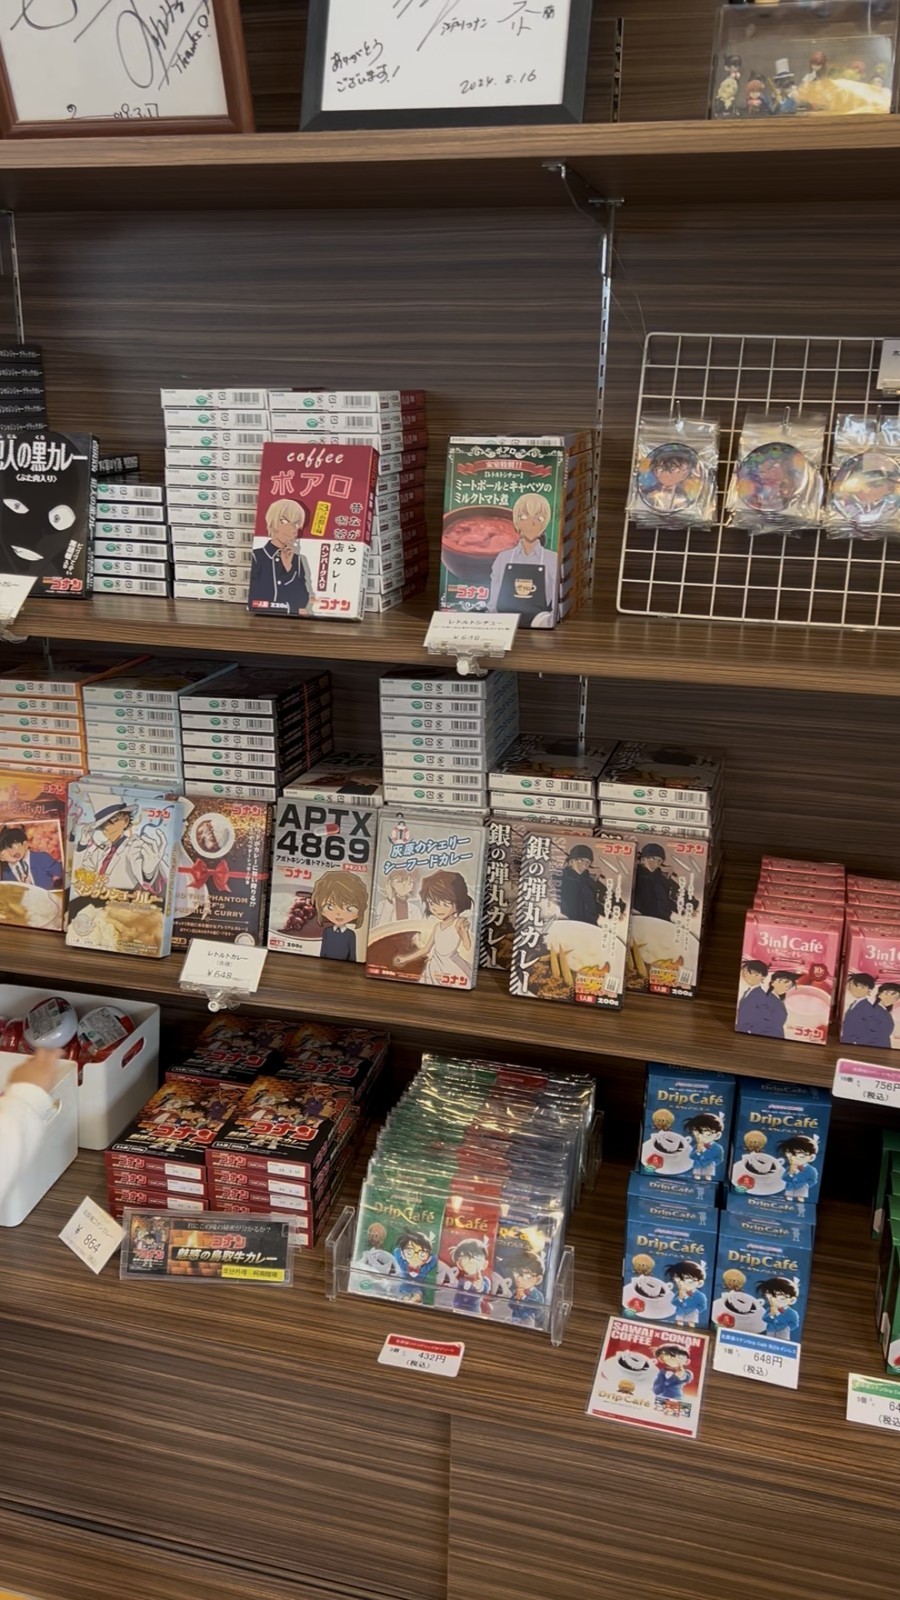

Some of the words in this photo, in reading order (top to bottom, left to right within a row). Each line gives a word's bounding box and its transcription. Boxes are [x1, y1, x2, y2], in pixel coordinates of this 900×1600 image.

[286, 447, 345, 468] coffee
[495, 446, 517, 455] ポアロ
[270, 469, 353, 499] ポアロ
[455, 479, 553, 493] ミートボールとキャベツの
[454, 492, 509, 506] ミルクトマト煮
[50, 577, 83, 591] コナン
[455, 585, 490, 600] コナン
[319, 598, 351, 612] コナン
[147, 809, 171, 819] コナン
[231, 804, 262, 817] コナン
[278, 803, 373, 838] APTX
[276, 830, 370, 864] 4869
[390, 835, 471, 858] 灰原のシェリー
[604, 844, 632, 856] コナン
[675, 843, 705, 855] コナン
[383, 851, 473, 875] シーフードカレー
[284, 868, 312, 880] コナン
[486, 822, 511, 967] 銀の弾丸カレー
[214, 910, 245, 918] CURRY
[518, 835, 551, 994] 銀の弾丸カレー
[758, 931, 824, 954] 3in1Café
[208, 950, 249, 961] レトルトカレー
[441, 975, 468, 986] コナン
[794, 1026, 824, 1040] コナン
[204, 1049, 267, 1068] コナン
[297, 1060, 359, 1078] コナン
[657, 1089, 724, 1106] DripCafé
[863, 1090, 889, 1101] (税込)
[749, 1112, 819, 1129] DripCafé
[149, 1122, 218, 1144] コナン
[246, 1120, 320, 1142] コナン
[83, 1233, 101, 1254] 864
[211, 1233, 247, 1249] コナン
[636, 1235, 705, 1255] DripCafé
[176, 1247, 278, 1264] 魅惑の鳥取牛カレー
[727, 1249, 799, 1272] DripCafé
[610, 1330, 652, 1346] COFFEE
[613, 1321, 655, 1338] SAWAI
[660, 1332, 701, 1348] CONAN
[418, 1352, 446, 1364] 432円
[753, 1352, 783, 1368] 648円
[743, 1364, 769, 1376] (税込)
